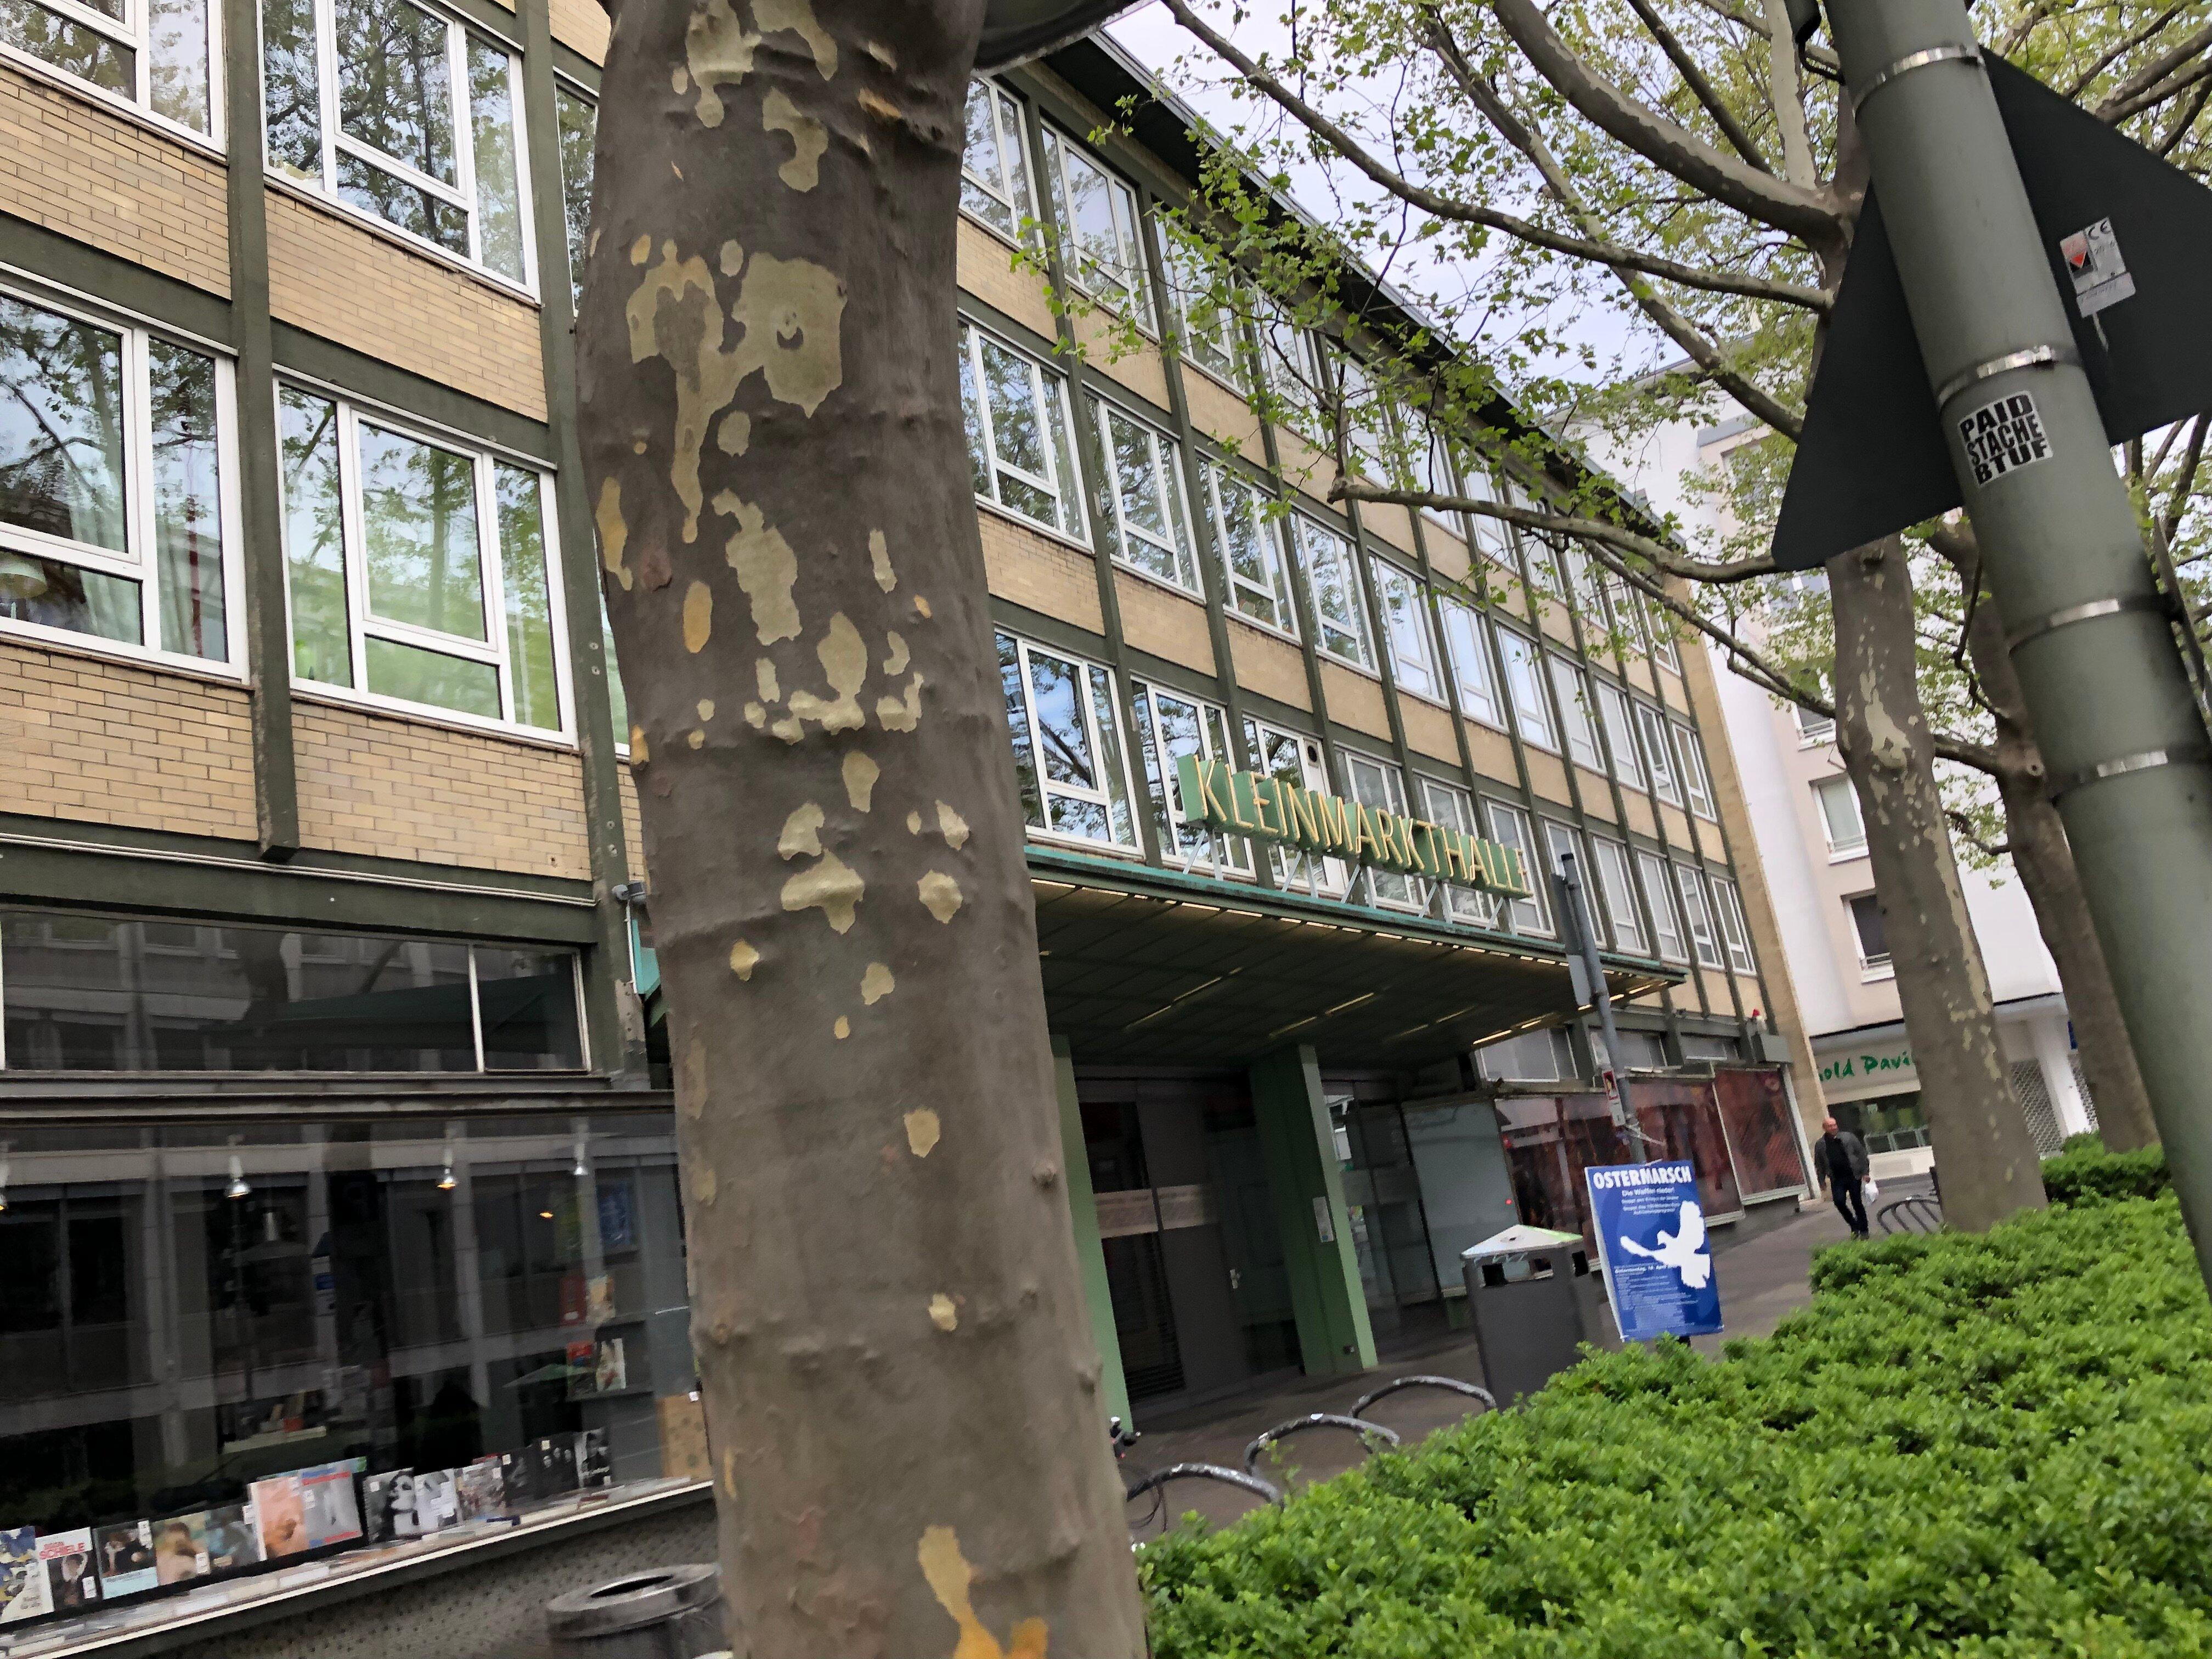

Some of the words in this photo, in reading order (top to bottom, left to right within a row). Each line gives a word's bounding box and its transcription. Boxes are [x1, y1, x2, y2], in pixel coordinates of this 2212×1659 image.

[1960, 395, 2033, 442] PAID
[1967, 414, 2043, 465] STACHE
[1975, 438, 2047, 484] BTUF
[1177, 753, 1534, 898] KLEINMARKTHALLE
[1593, 1165, 1692, 1189] OSTERMARSCH
